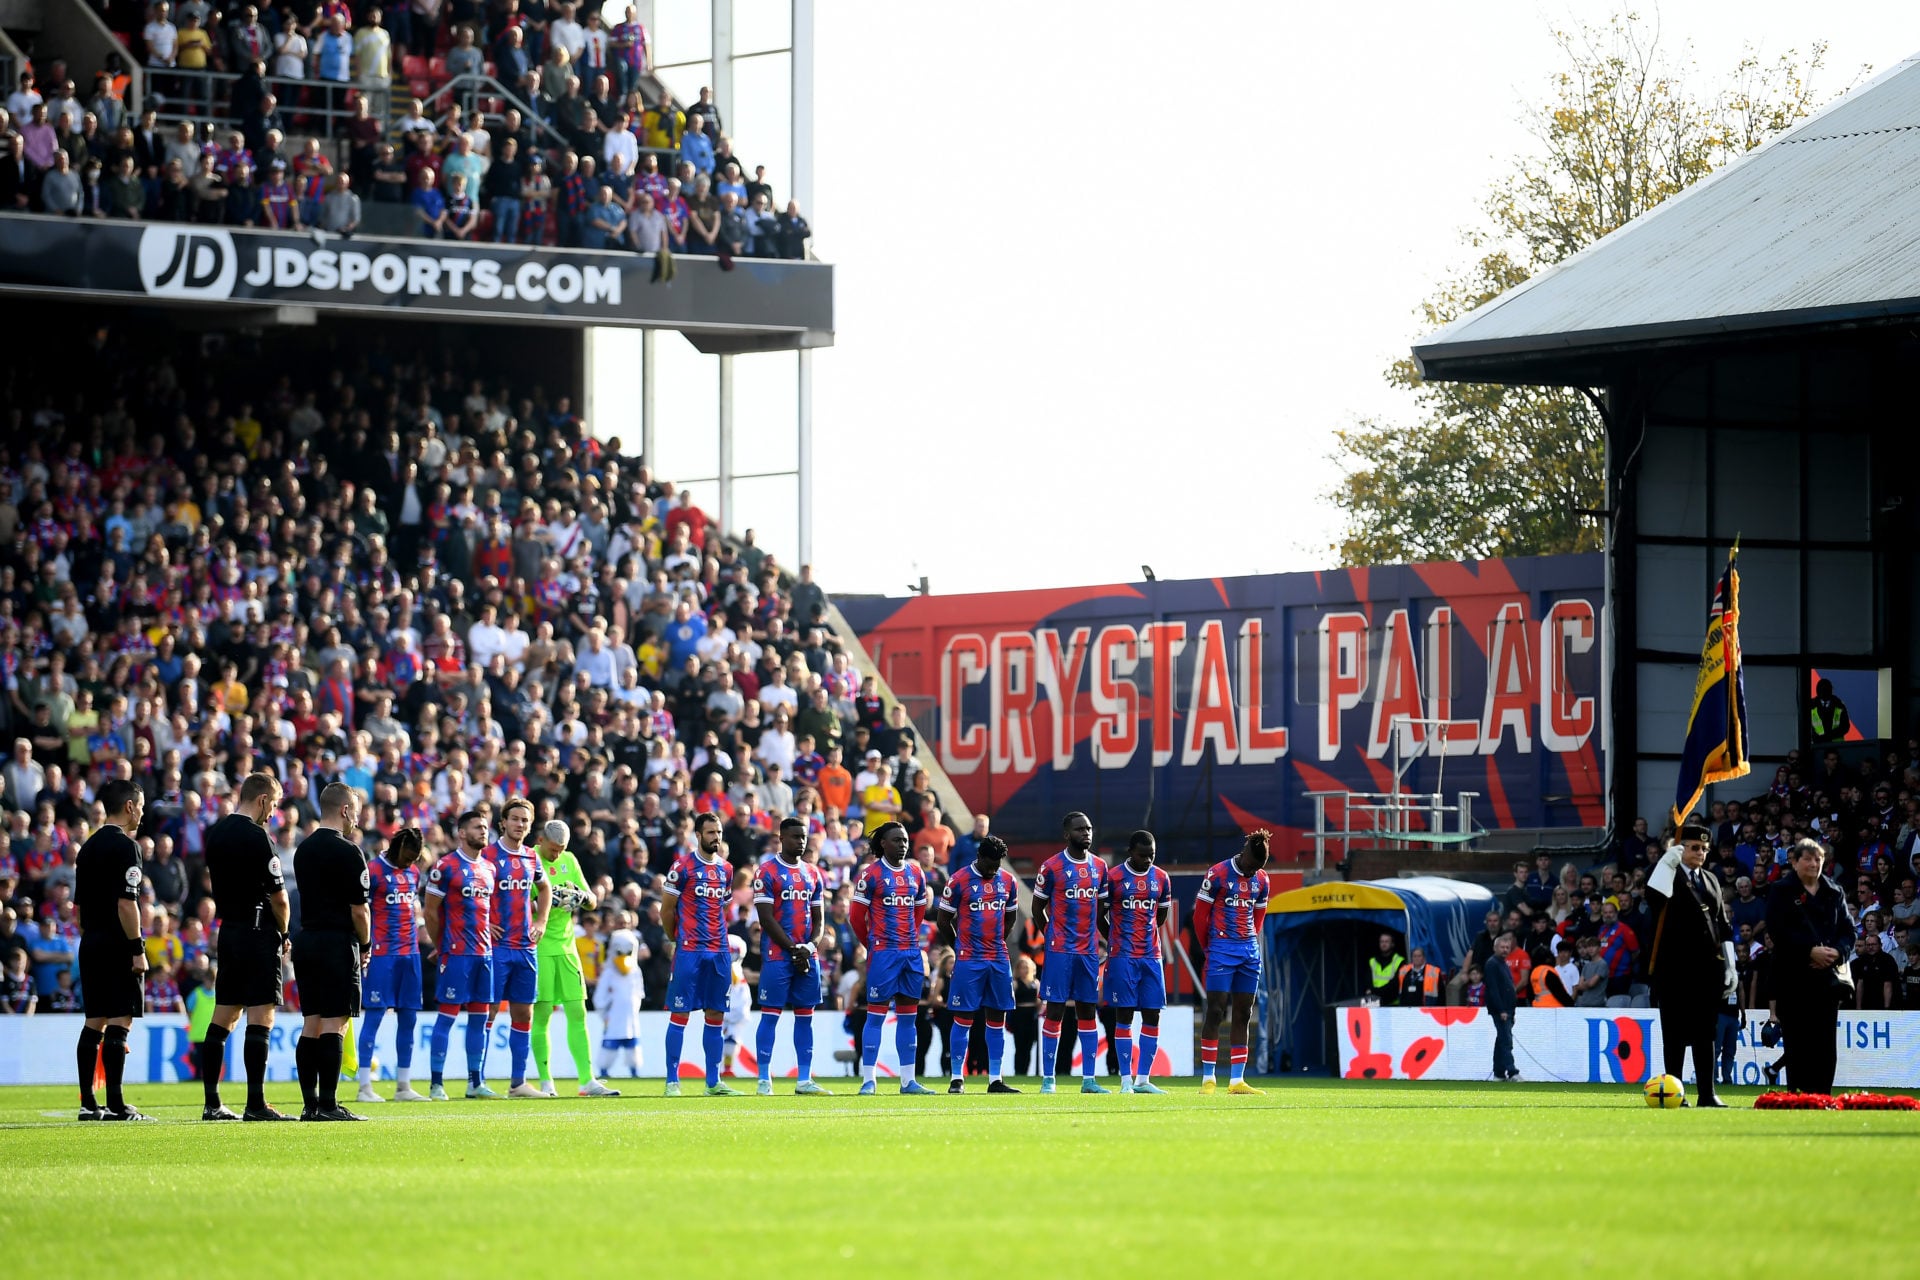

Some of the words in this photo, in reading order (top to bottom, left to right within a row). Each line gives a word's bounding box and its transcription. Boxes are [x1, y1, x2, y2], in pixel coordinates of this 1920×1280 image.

[154, 233, 224, 288] JD
[243, 246, 622, 305] JDSPORTS.COM
[940, 617, 1289, 774] CRYSTAL
[1318, 598, 1606, 762] PALAC
[499, 875, 533, 891] cinch
[781, 885, 813, 901] cinch
[1064, 884, 1099, 899] cinch
[969, 897, 1006, 912] cinch
[1121, 895, 1157, 911] cinch
